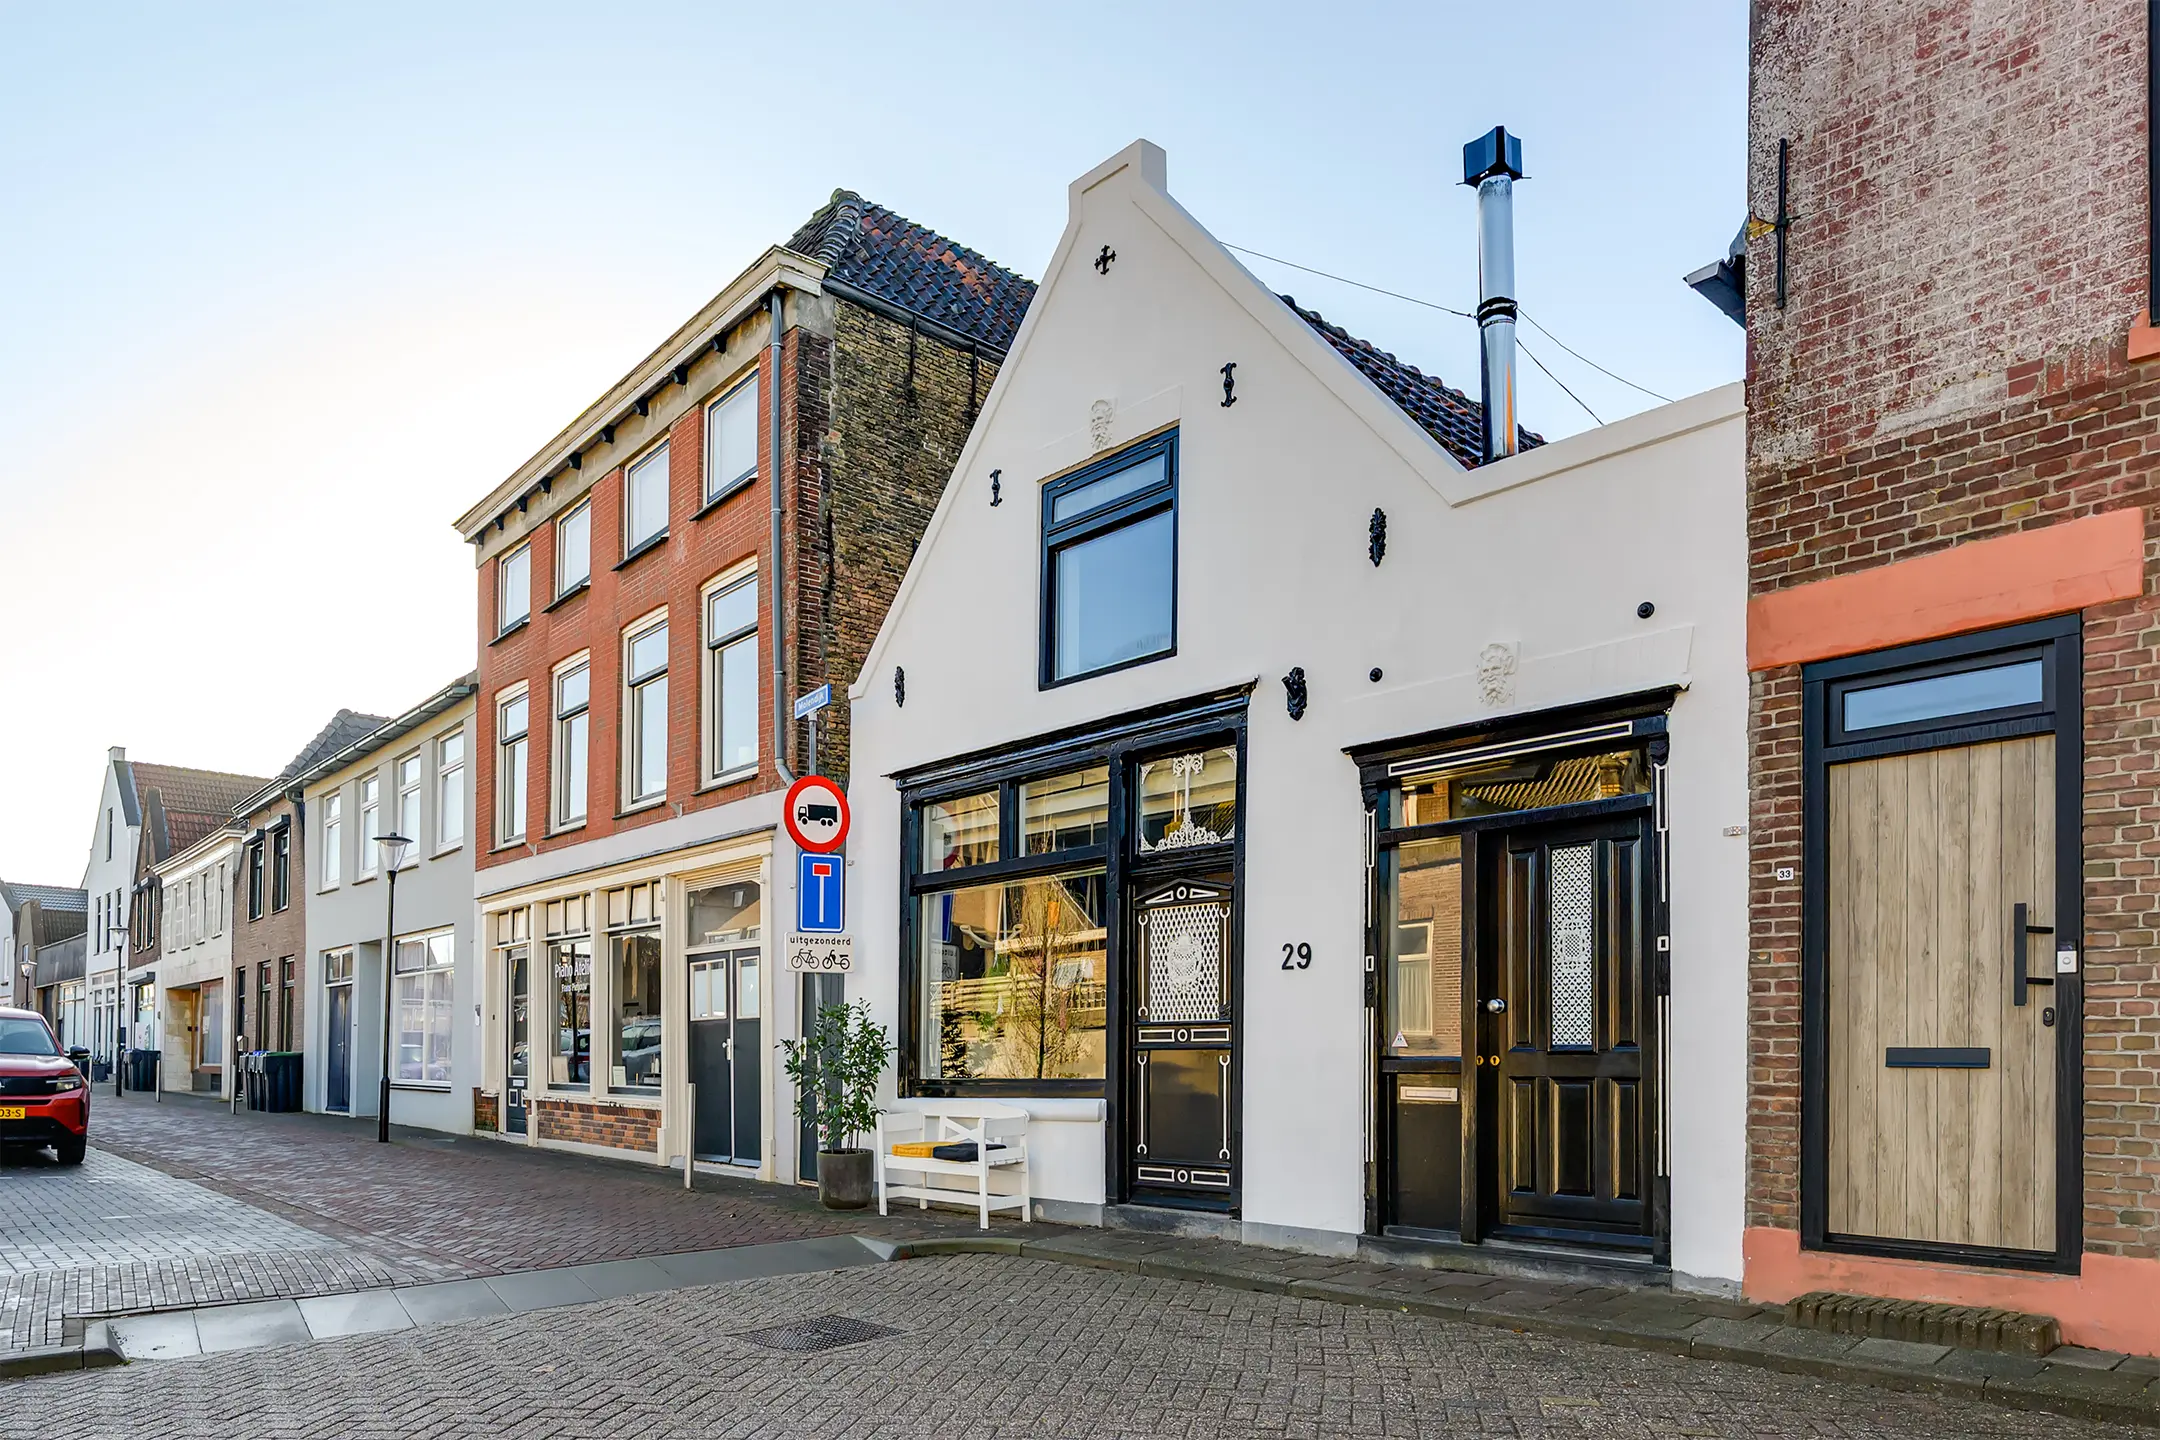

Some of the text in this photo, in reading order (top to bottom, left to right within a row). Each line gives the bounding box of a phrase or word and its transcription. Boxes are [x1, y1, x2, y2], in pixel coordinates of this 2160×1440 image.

[1779, 869, 1791, 879] 33
[789, 936, 851, 946] uitgezonderd
[1281, 942, 1312, 970] 29
[554, 959, 591, 978] Piano Ateli
